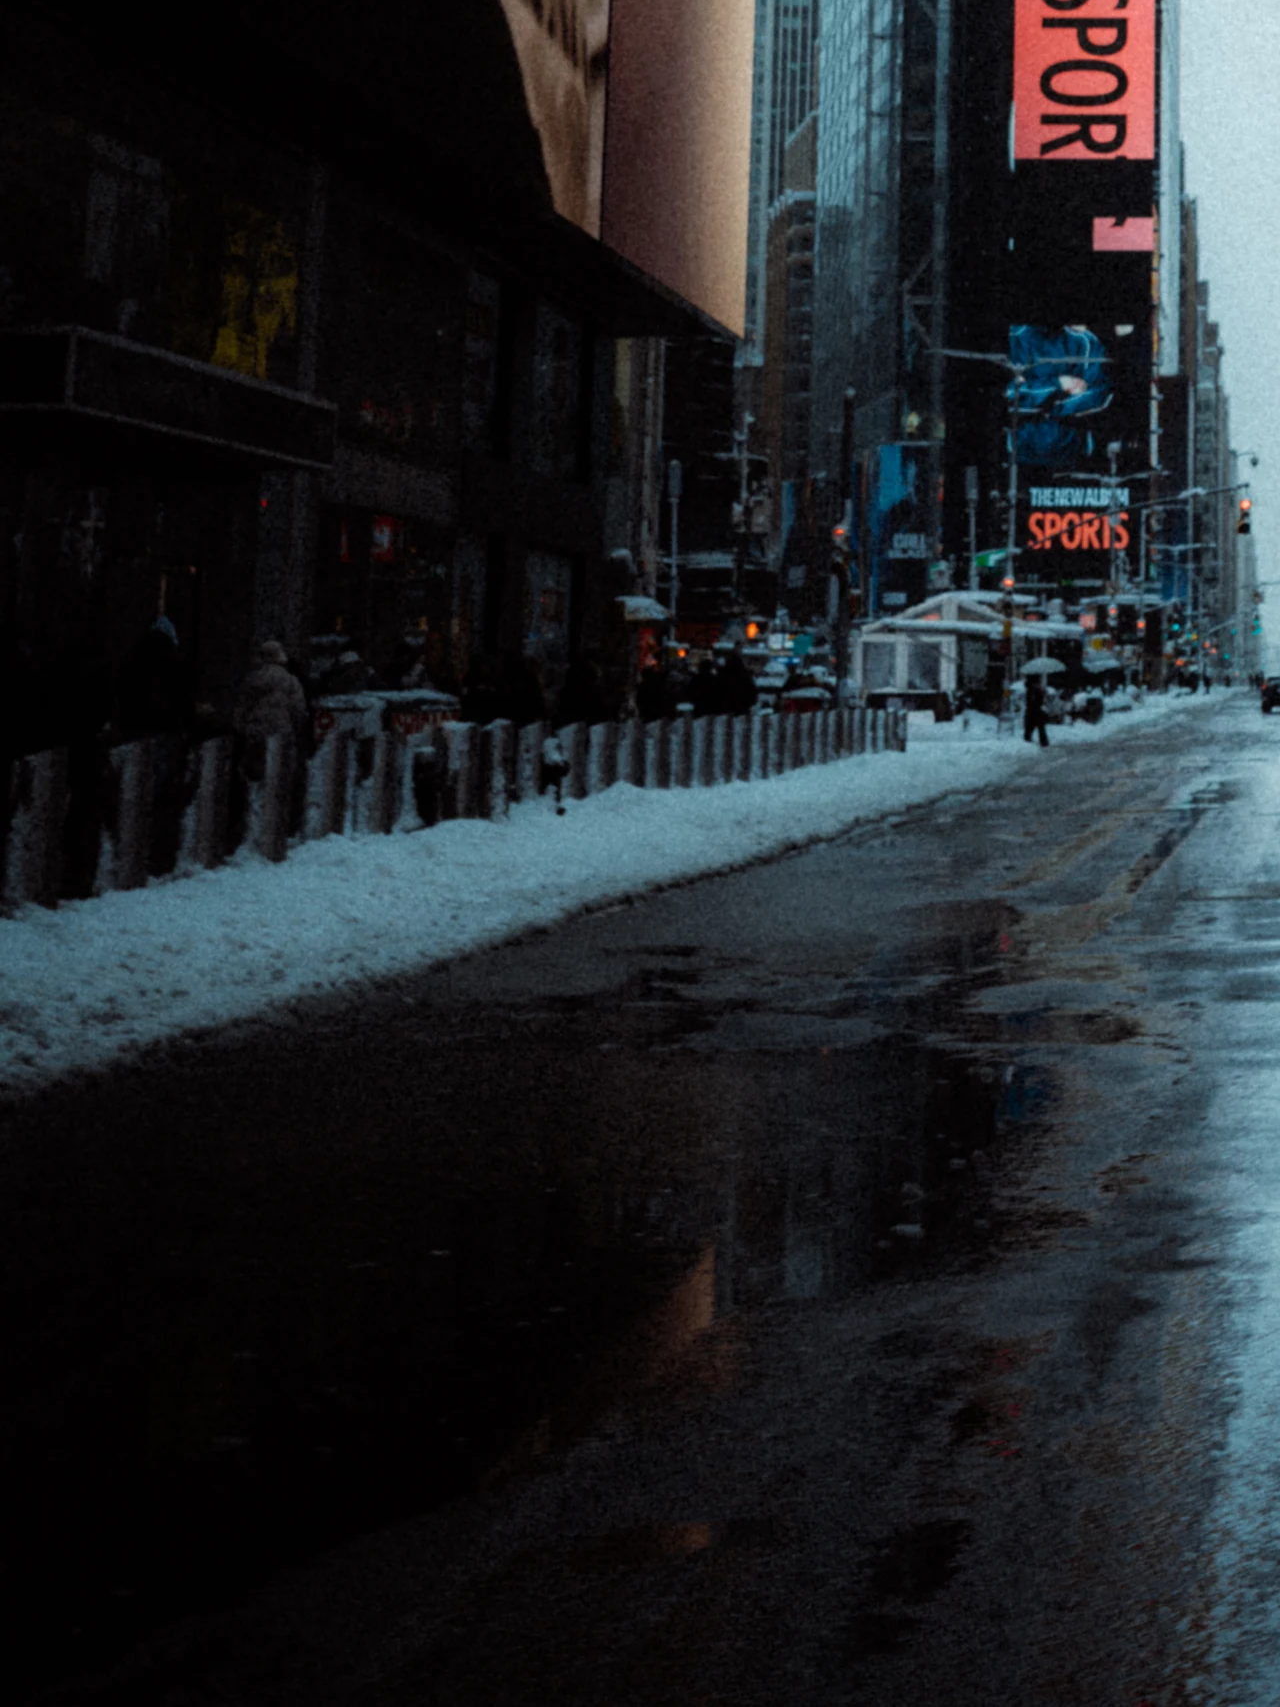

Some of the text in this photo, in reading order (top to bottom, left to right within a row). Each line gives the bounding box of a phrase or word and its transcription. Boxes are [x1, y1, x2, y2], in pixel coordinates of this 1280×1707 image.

[1029, 486, 1130, 507] THE NEW ALBM
[1027, 511, 1130, 550] SPORTS
